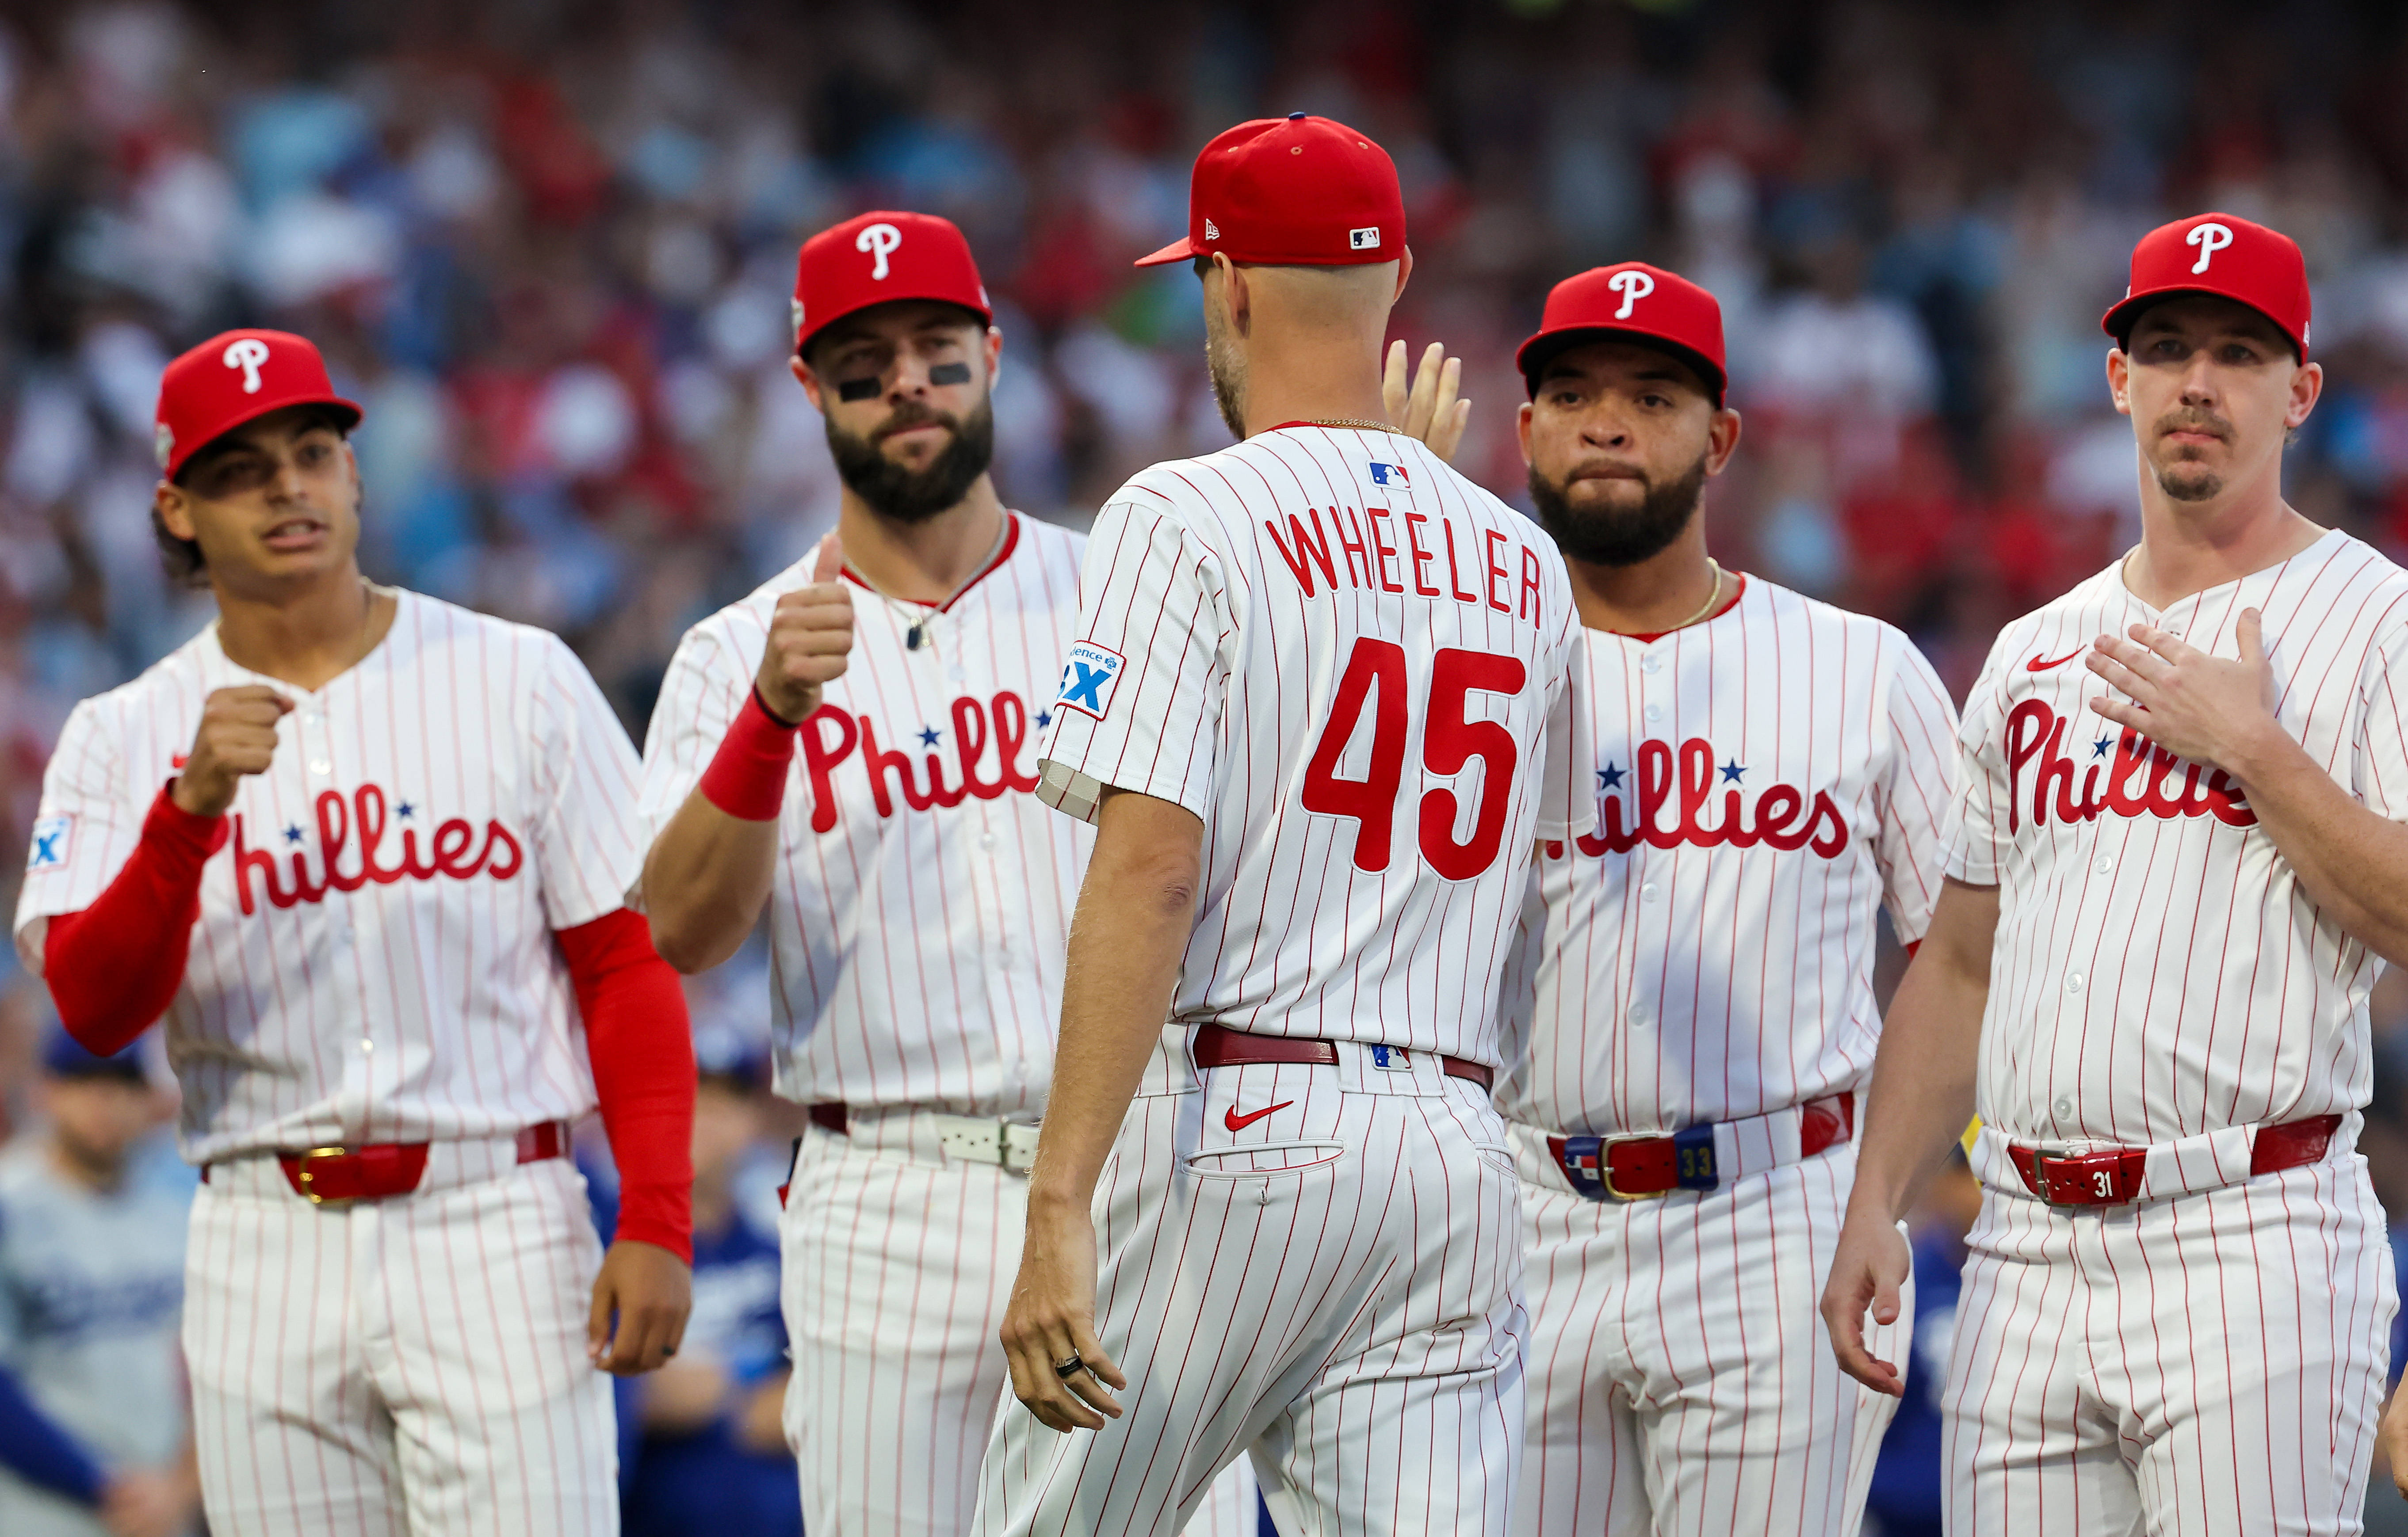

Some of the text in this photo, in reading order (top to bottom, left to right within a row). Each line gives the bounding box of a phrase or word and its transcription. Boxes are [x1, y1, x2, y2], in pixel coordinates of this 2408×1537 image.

[856, 223, 902, 280] P
[2186, 223, 2233, 275] P
[1608, 270, 1655, 320] P
[222, 339, 270, 394] P
[1265, 505, 1542, 629] WHEELER
[1056, 661, 1112, 712] X
[796, 691, 1050, 833] Phill
[1301, 637, 1526, 881] 45
[1546, 737, 1849, 859] illies
[210, 783, 523, 915] hillies
[1682, 1148, 1711, 1178] 33
[2093, 1171, 2113, 1198] 31
